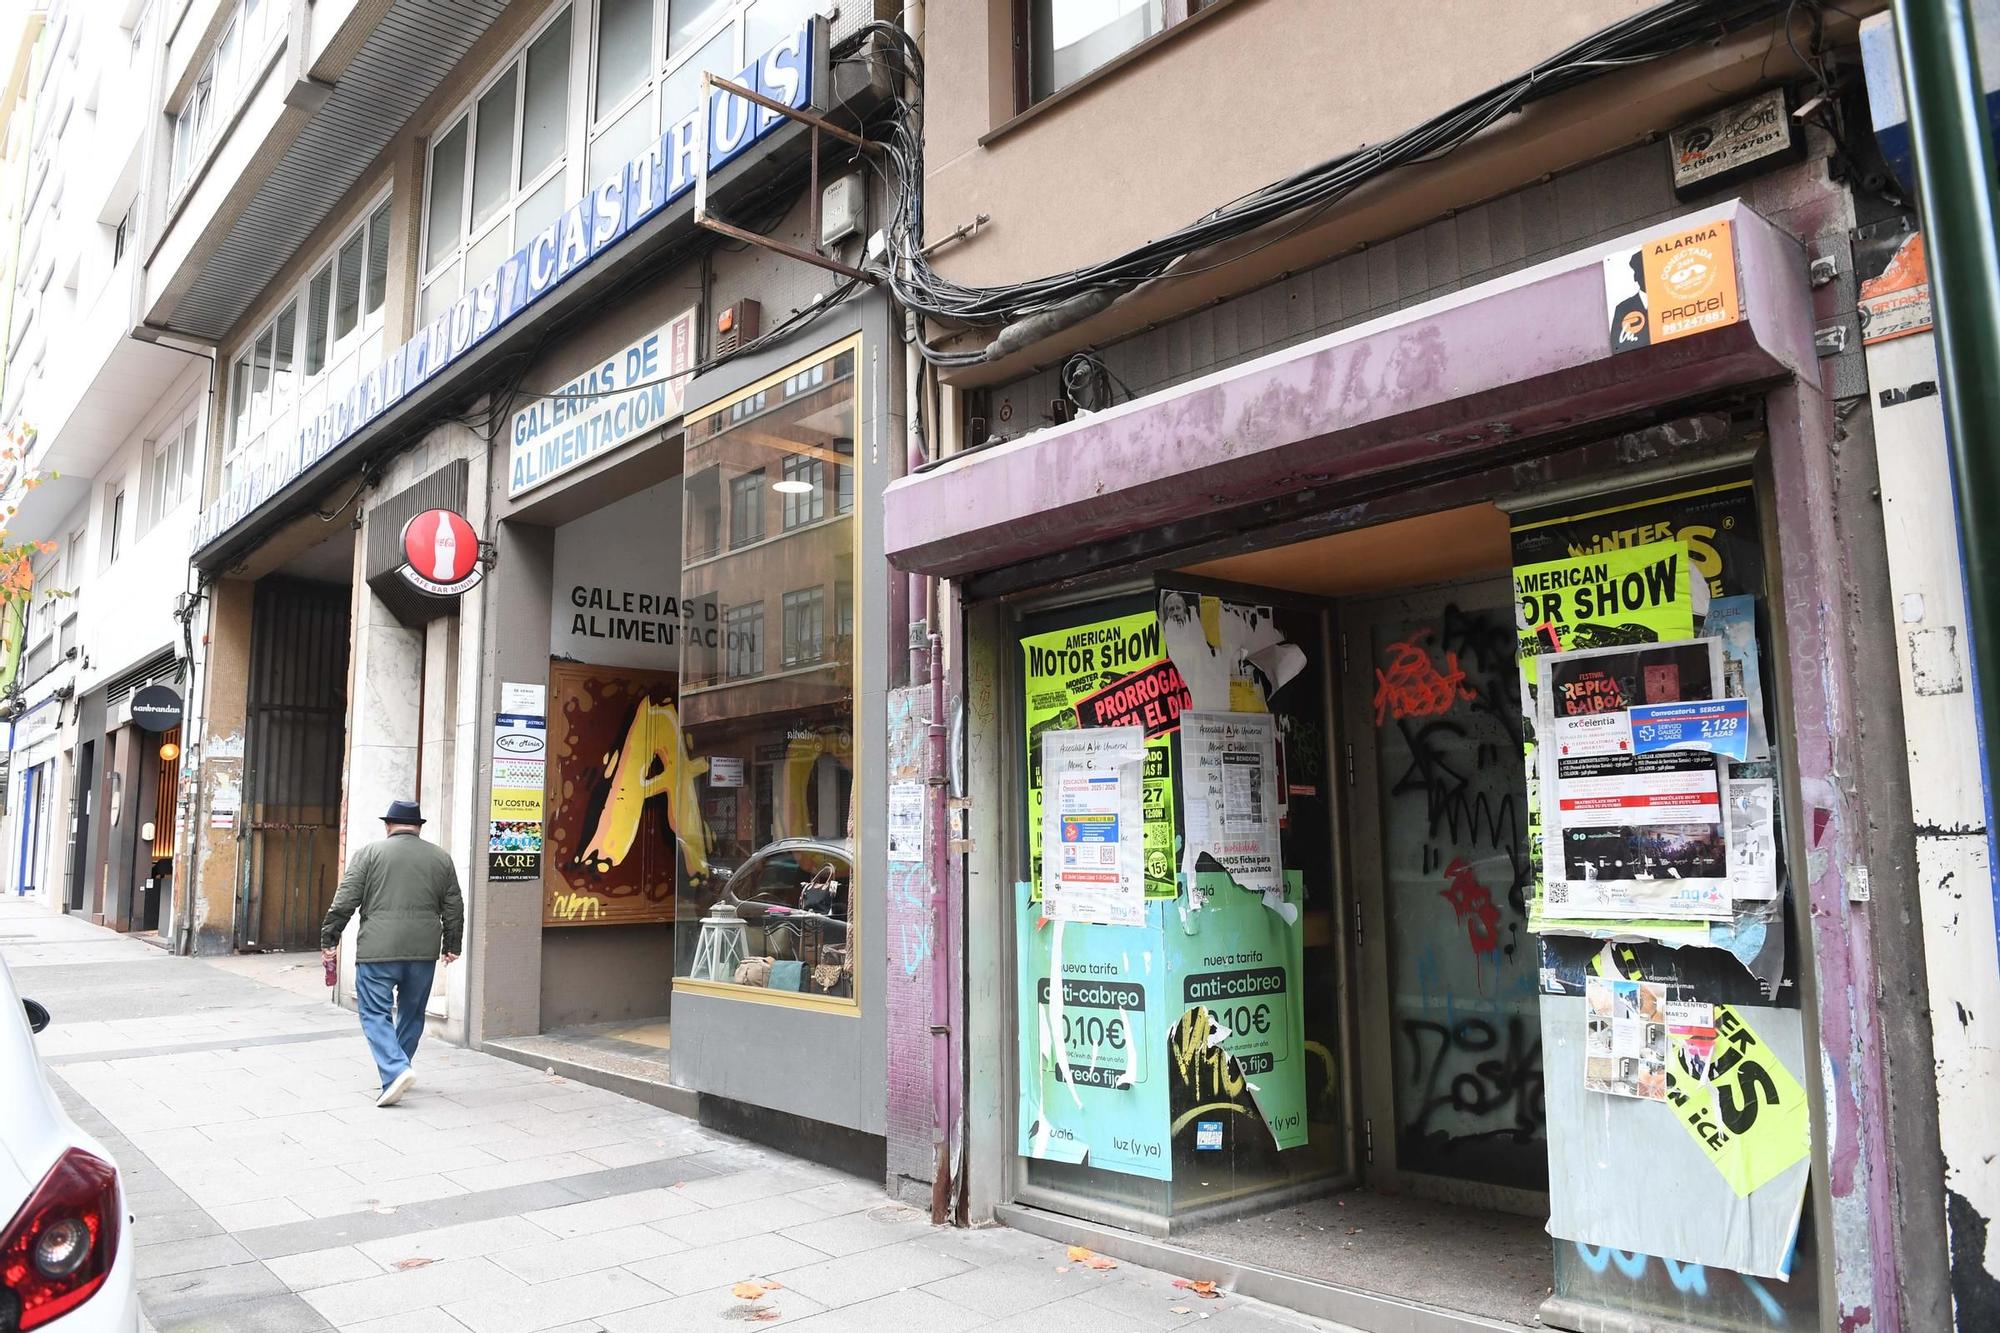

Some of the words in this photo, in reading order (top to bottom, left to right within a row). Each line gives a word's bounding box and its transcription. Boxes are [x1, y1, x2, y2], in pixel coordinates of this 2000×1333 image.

[528, 42, 803, 292] CASTROS
[1655, 229, 1718, 255] ALARMA
[1660, 248, 1713, 280] CONECTADA
[515, 361, 615, 447] GALERIAS
[625, 334, 659, 387] DE
[512, 382, 666, 491] ALIMENTACION
[409, 572, 430, 588] CAFE
[1574, 553, 1677, 620] SHOW
[431, 585, 448, 594] BAR
[570, 585, 695, 622] GALERIAS
[703, 602, 730, 624] DE
[570, 613, 756, 653] ALIMENTACION
[1065, 626, 1121, 650] AMERICAN
[1029, 645, 1095, 678] MOTOR
[1100, 620, 1160, 669] SHOW
[1066, 672, 1099, 690] MONSTER
[1071, 684, 1095, 695] TRUCK
[1564, 676, 1620, 701] REPICA
[133, 703, 181, 714] sanbrandan
[1144, 701, 1168, 728] EL
[1650, 707, 1696, 717] Convocatoria
[1699, 705, 1725, 714] SERGAS
[1701, 718, 1738, 733] 2.128
[1703, 729, 1735, 738] PLAZAS
[494, 799, 504, 807] TU
[505, 799, 541, 808] COSTURA
[494, 854, 536, 868] ACRE
[1240, 855, 1257, 864] ficha
[1257, 856, 1271, 865] para
[1203, 955, 1235, 967] nueva
[1236, 950, 1263, 964] tarifa
[1061, 963, 1087, 974] ueva
[1089, 962, 1118, 975] tarifa
[1189, 973, 1281, 998] anti-cabreo
[1683, 1001, 1708, 1009] CENTRO
[1249, 1056, 1268, 1074] fijo
[1113, 1137, 1129, 1150] luz
[1131, 1138, 1142, 1155] (y
[1143, 1142, 1162, 1158] ya)
